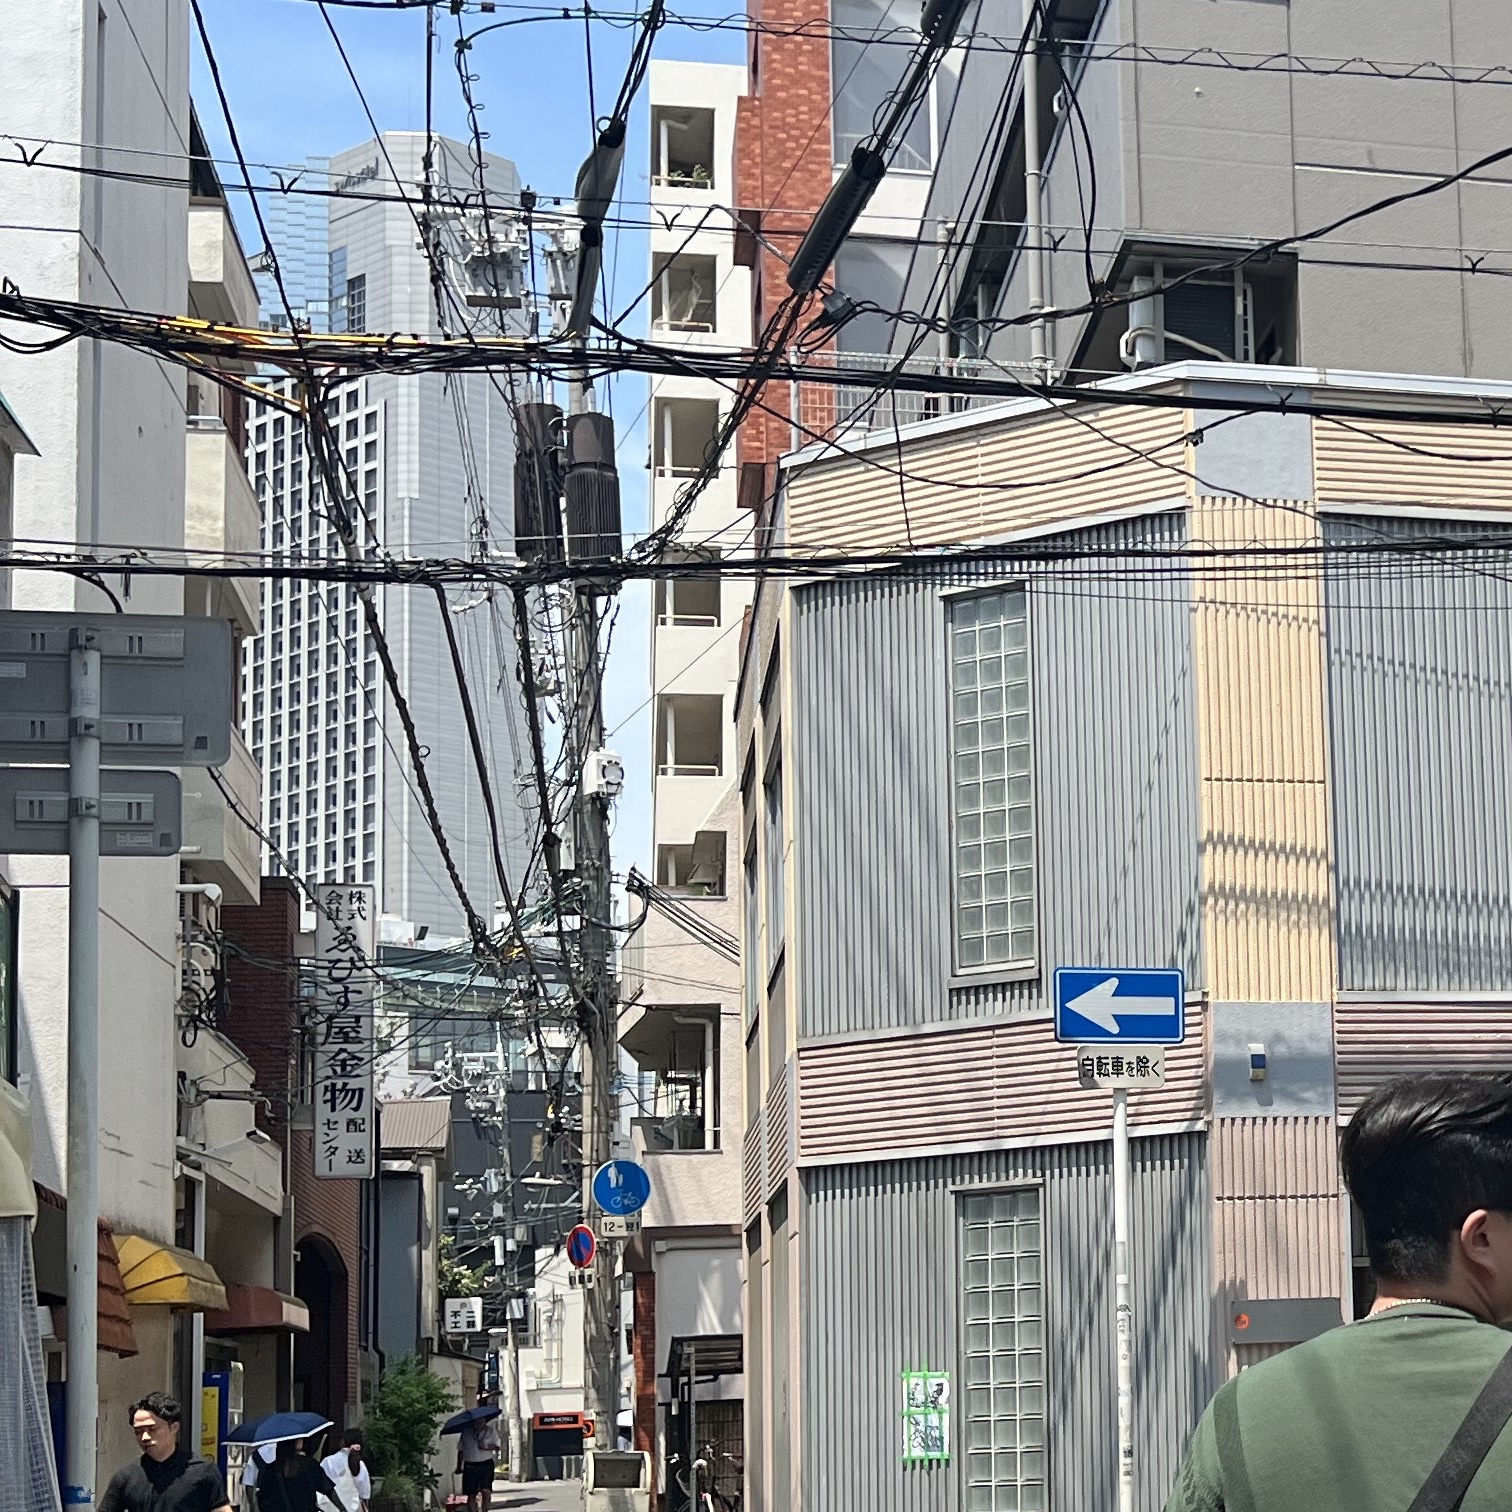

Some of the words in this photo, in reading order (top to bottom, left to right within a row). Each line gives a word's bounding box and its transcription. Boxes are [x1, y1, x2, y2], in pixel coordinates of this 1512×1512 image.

[1081, 1055, 1161, 1079] 自転車を除く
[321, 1118, 340, 1172] センター
[346, 1117, 366, 1165] 配送
